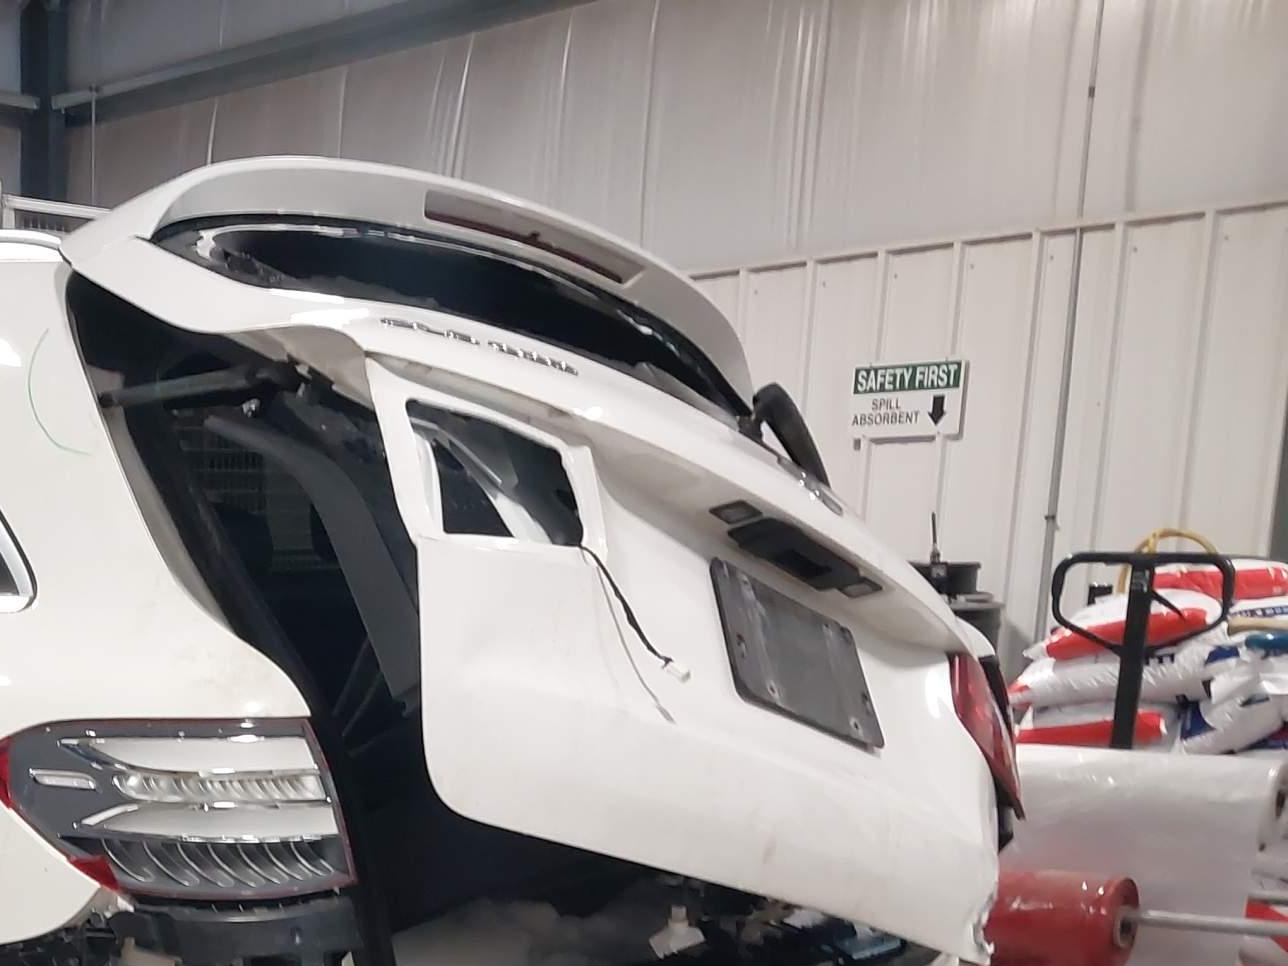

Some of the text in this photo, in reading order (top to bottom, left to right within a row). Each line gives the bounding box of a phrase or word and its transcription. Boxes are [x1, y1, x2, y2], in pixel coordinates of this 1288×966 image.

[857, 364, 958, 392] SAFETY FIRST
[871, 398, 901, 411] SPILL
[852, 411, 920, 427] ABSORBENT
